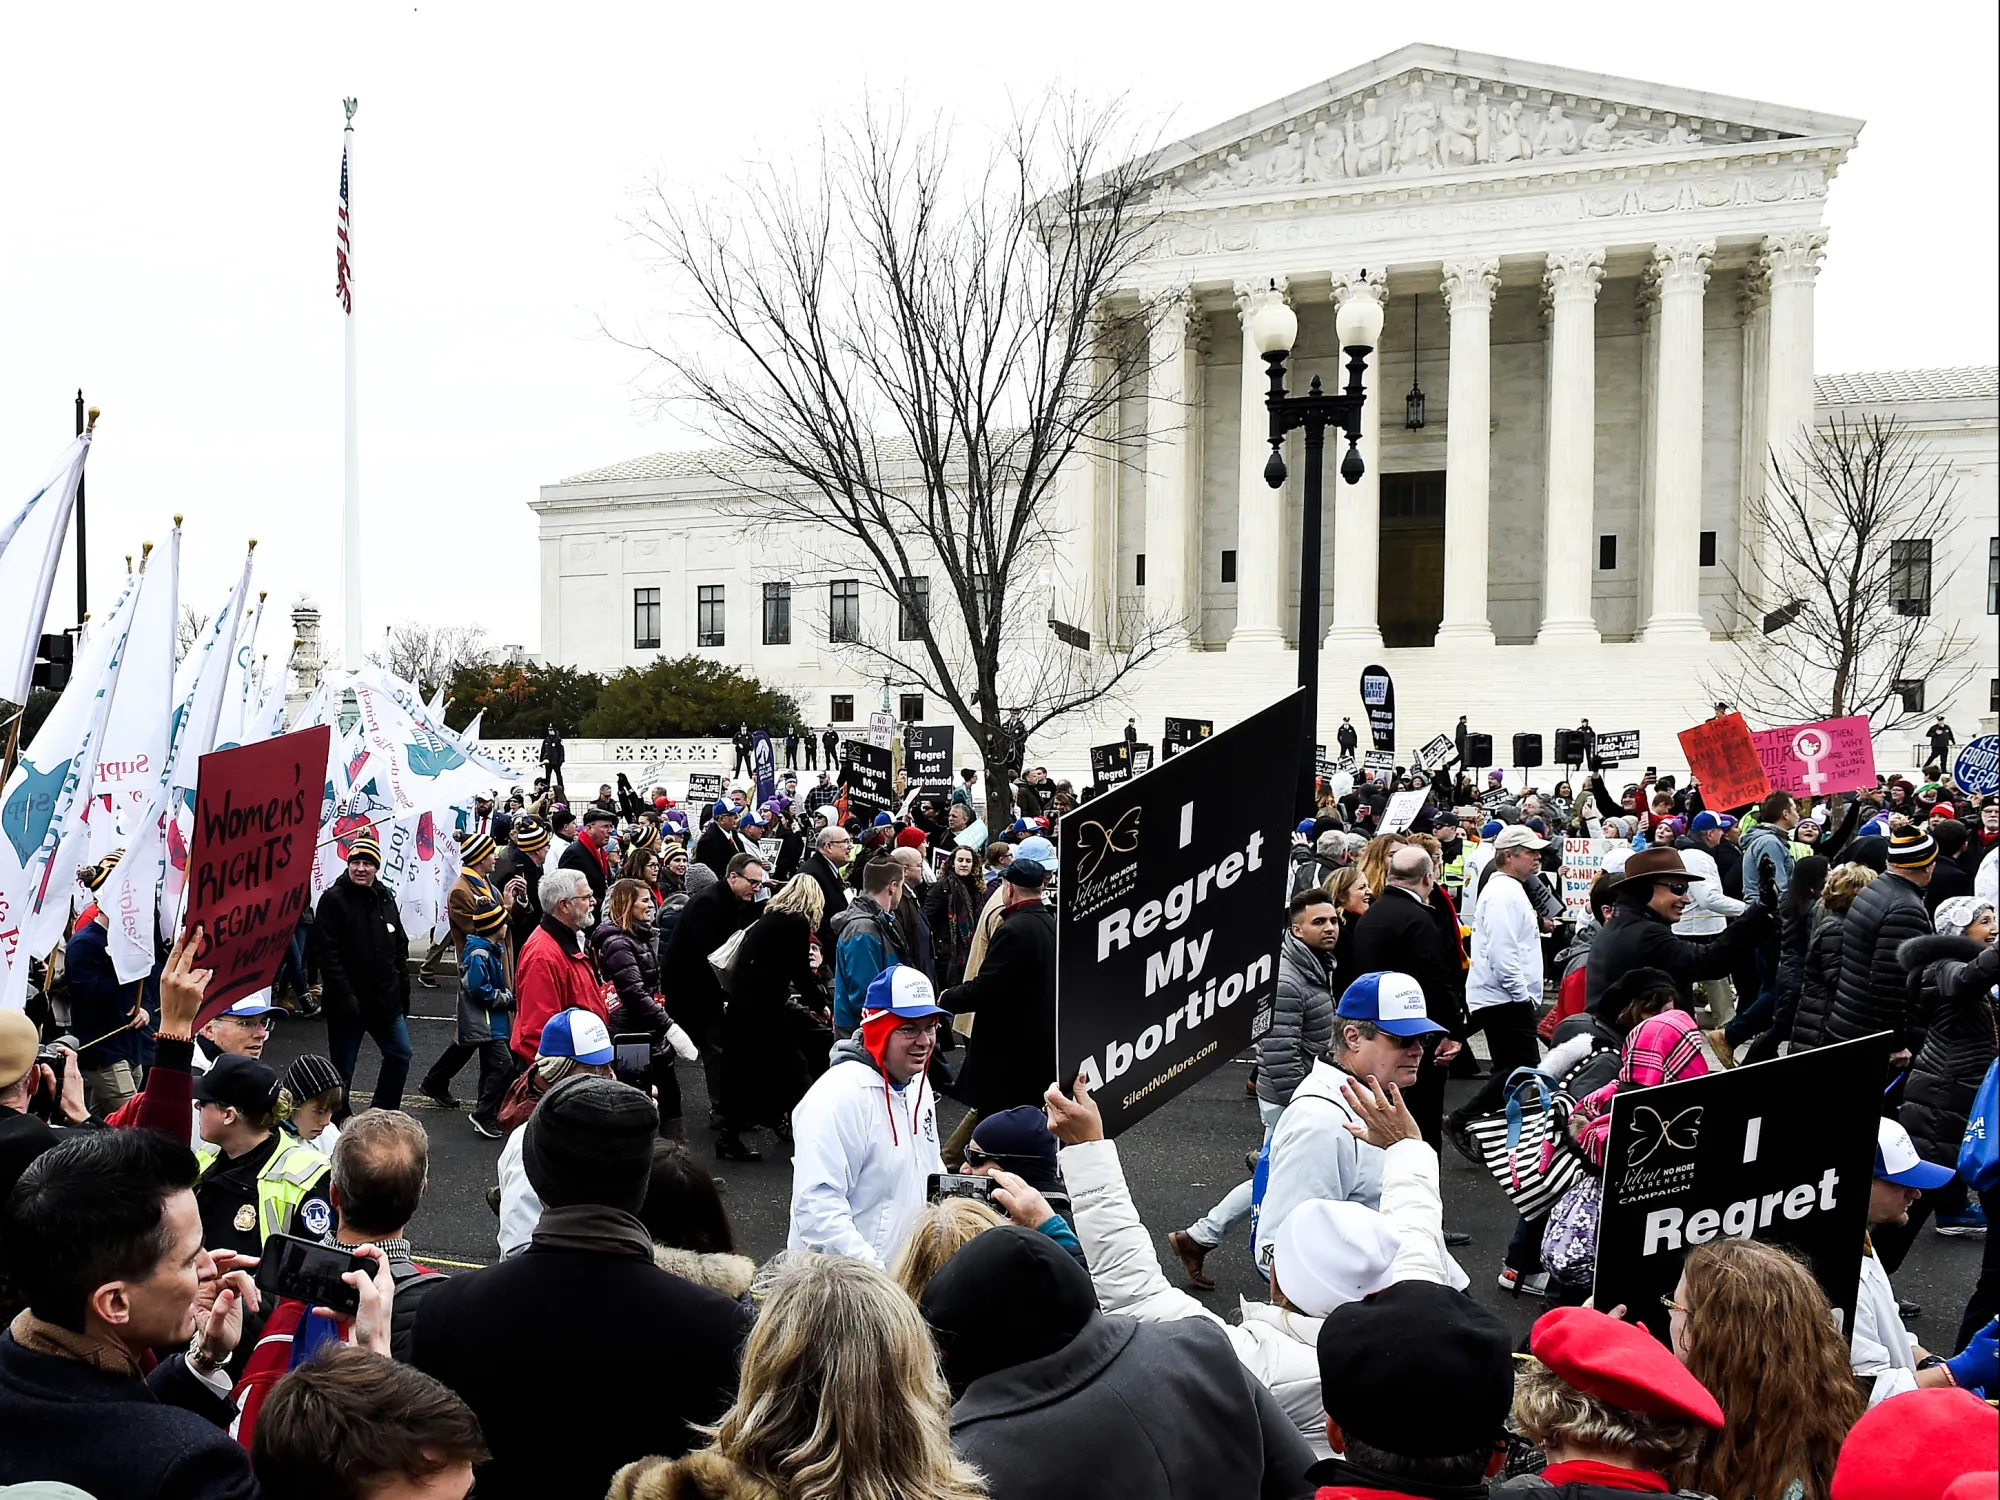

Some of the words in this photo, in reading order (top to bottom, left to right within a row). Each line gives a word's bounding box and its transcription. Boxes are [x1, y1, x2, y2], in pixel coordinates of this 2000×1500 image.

[1273, 223, 1345, 243] EQUAL
[1347, 214, 1429, 236] JUSTICE
[1441, 205, 1509, 226] UNDER
[1520, 201, 1563, 219] LAW
[877, 716, 887, 725] NO
[928, 737, 933, 747] I
[1764, 729, 1795, 744] THE
[1830, 729, 1854, 739] THEN
[1841, 739, 1864, 748] WHY
[1597, 740, 1639, 752] PRO-LIFE
[1978, 736, 1999, 752] KE
[914, 750, 946, 761] Regret
[1828, 752, 1843, 760] ARE
[1849, 748, 1864, 756] WE
[852, 762, 887, 780] Regret
[919, 764, 940, 773] Lost
[1098, 767, 1128, 781] Regret
[1767, 765, 1787, 778] IS
[1831, 768, 1860, 780] THEM?
[690, 783, 720, 792] PRO-LIFE
[862, 777, 877, 791] My
[848, 786, 891, 806] Abortion
[1715, 783, 1766, 807] WOMEN
[1179, 801, 1194, 849] I
[1565, 840, 1590, 854] OUR
[197, 833, 293, 912] RIGHTS
[1564, 868, 1603, 880] CANN
[1069, 875, 1108, 907] Silent
[1110, 872, 1120, 882] NO
[1120, 862, 1138, 877] MORE
[1072, 871, 1138, 912] AWARENESS
[1073, 883, 1135, 921] CAMPAIGN
[1097, 829, 1264, 963] Regret
[190, 896, 271, 962] BEGIN
[278, 882, 304, 919] IN
[1145, 928, 1214, 998] My
[1074, 953, 1271, 1095] Abortion
[1122, 1038, 1218, 1110] SilentNoMore.com
[1743, 1116, 1762, 1163] I
[1615, 1166, 1661, 1188] Silent
[1663, 1167, 1674, 1176] NO
[1675, 1163, 1695, 1174] MORE
[1618, 1171, 1695, 1195] AWARENESS
[1618, 1184, 1691, 1205] CAMPAIGN
[1643, 1168, 1840, 1256] Regret
